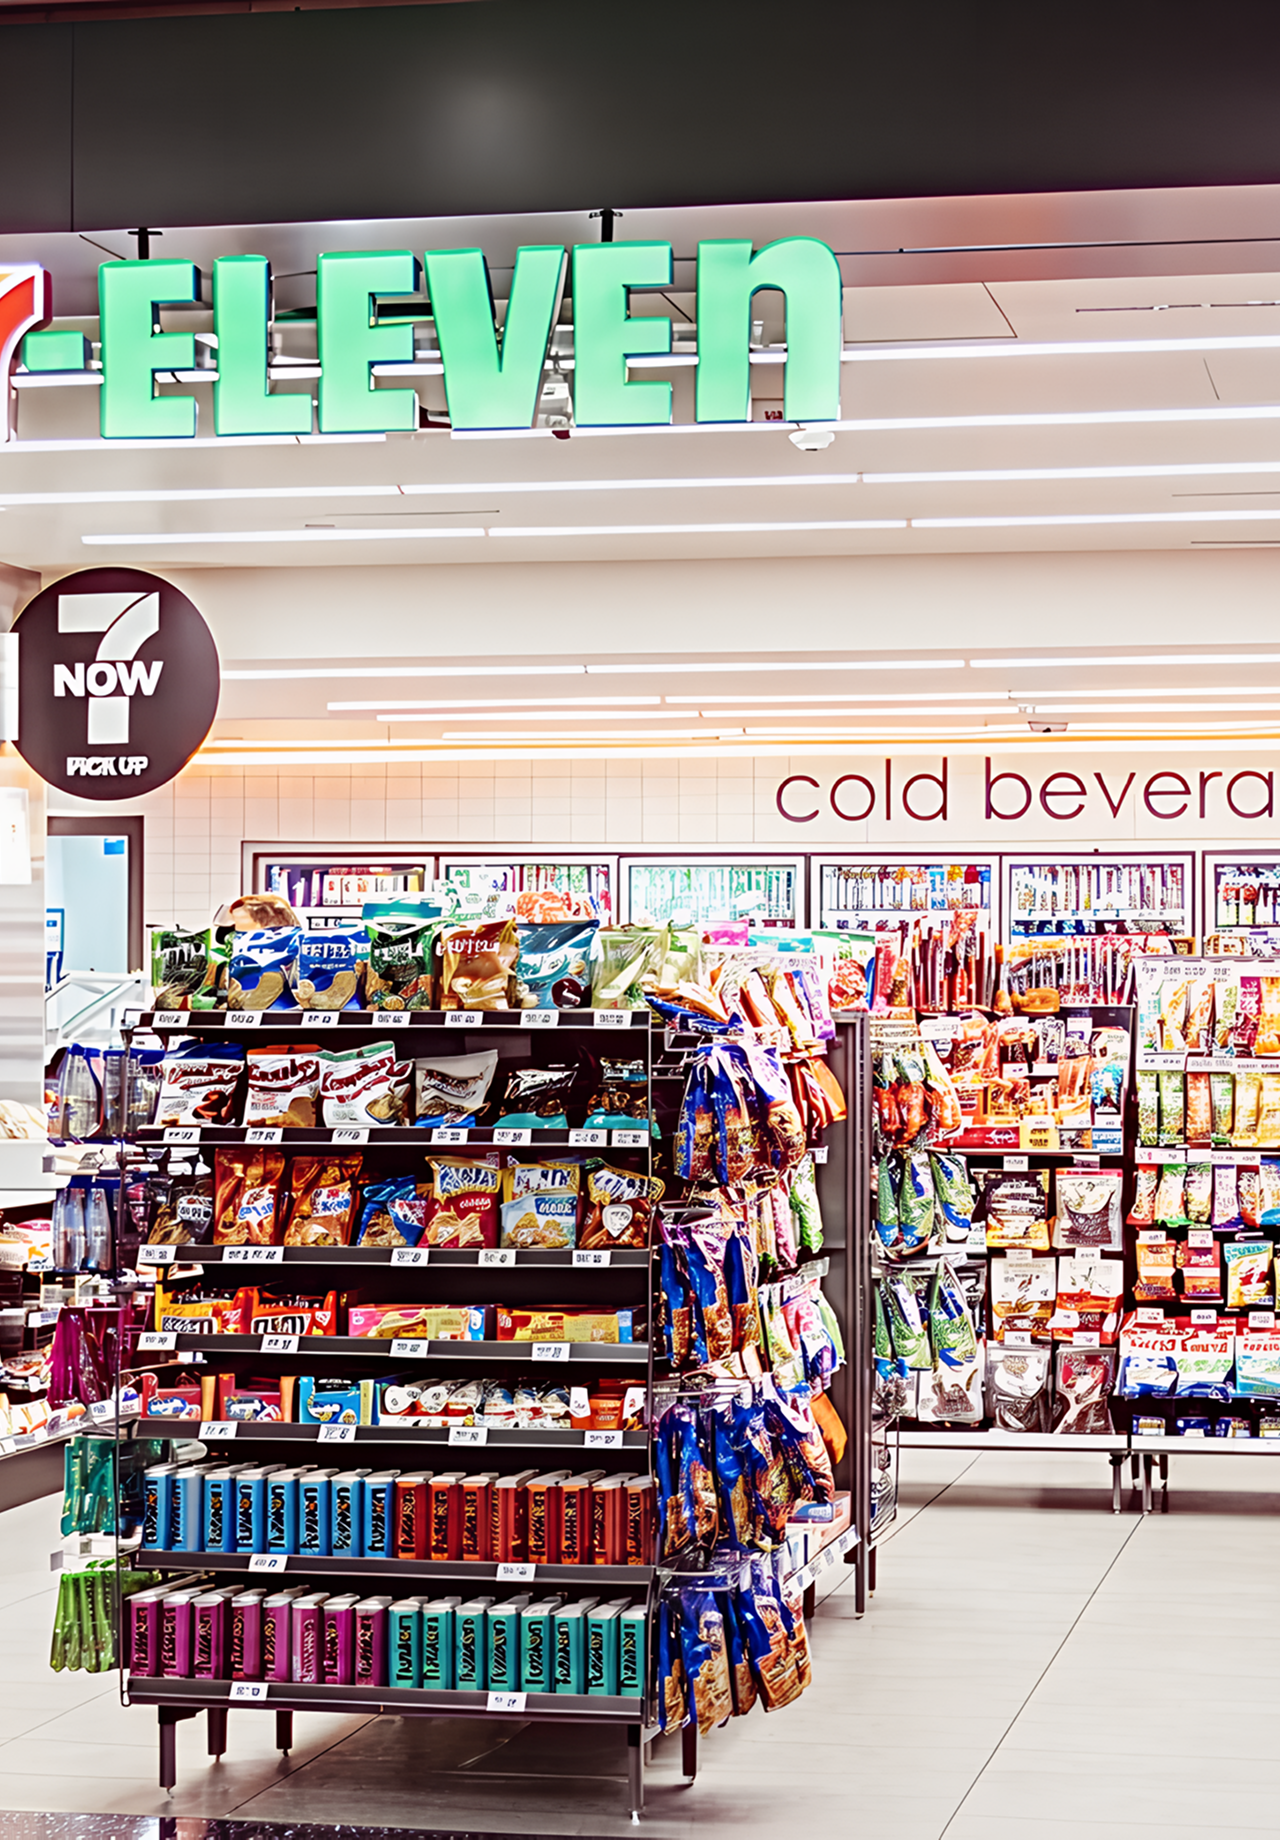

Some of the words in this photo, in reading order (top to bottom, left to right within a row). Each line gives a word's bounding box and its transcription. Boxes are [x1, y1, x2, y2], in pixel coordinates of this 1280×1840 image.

[53, 660, 164, 697] NOW
[118, 755, 149, 776] UP
[776, 757, 948, 823] cold
